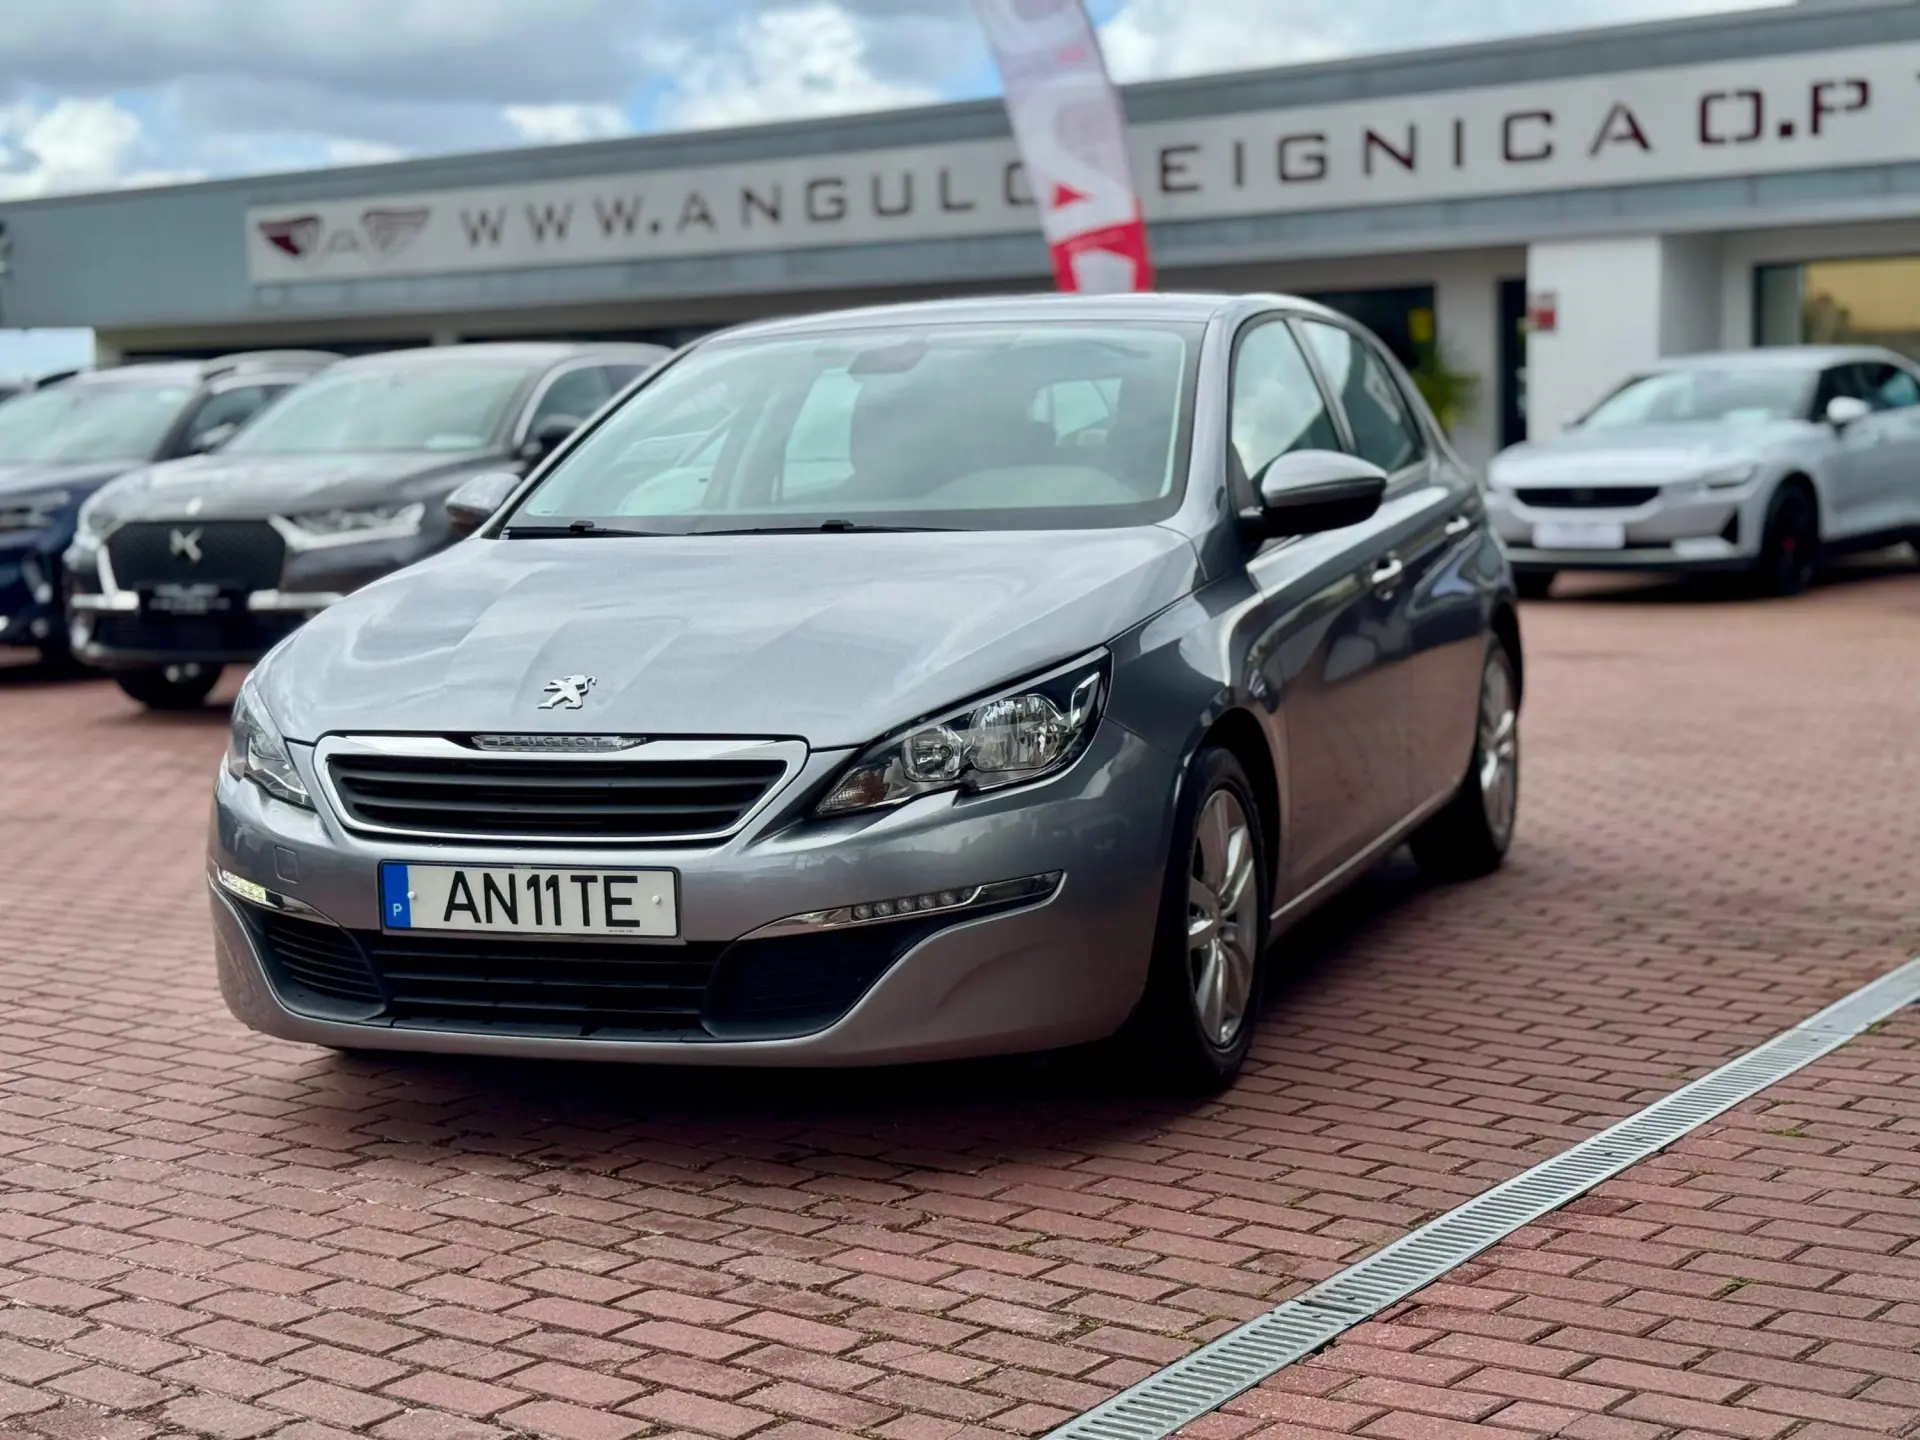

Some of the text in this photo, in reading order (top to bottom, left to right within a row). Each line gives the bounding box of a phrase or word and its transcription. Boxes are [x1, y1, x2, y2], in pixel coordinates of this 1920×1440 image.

[496, 736, 603, 747] PEUGEOT
[443, 871, 641, 928] AN11TE
[392, 903, 403, 917] P
